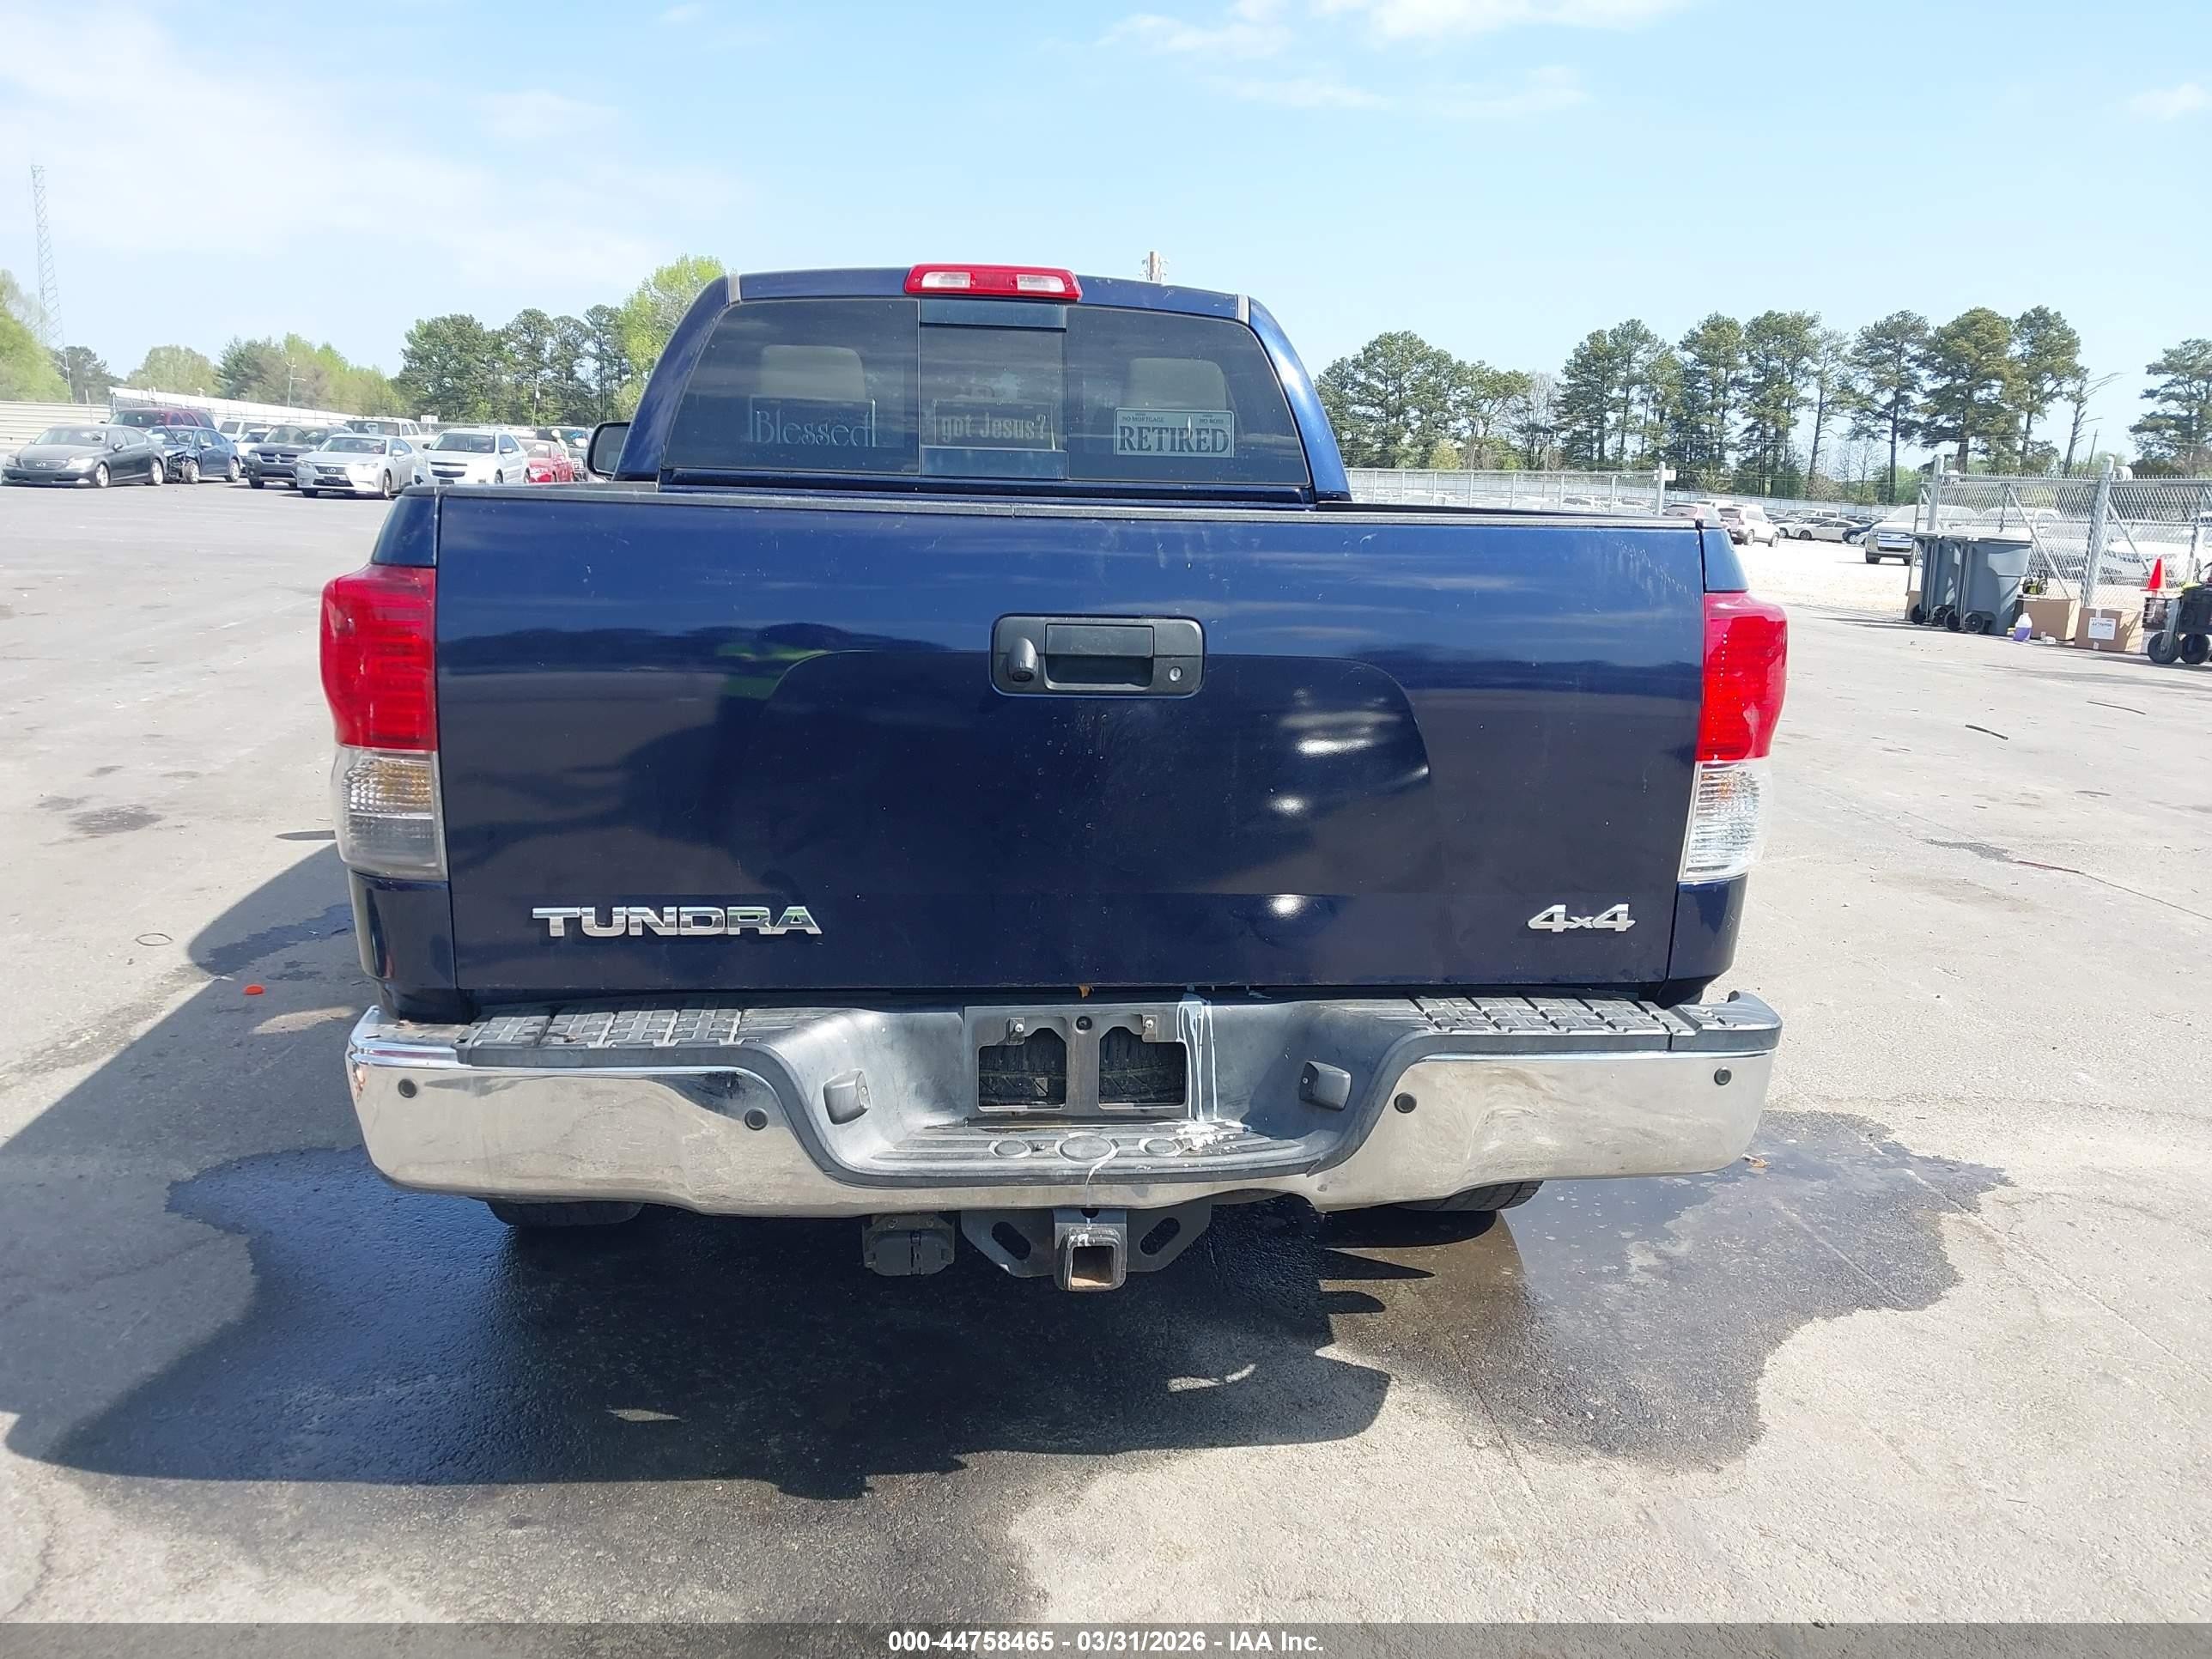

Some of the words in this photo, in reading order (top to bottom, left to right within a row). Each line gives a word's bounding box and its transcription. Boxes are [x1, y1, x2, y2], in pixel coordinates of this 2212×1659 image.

[756, 408, 870, 447] Blessed
[941, 414, 972, 442] got
[980, 412, 1046, 440] Jesus?
[1119, 425, 1230, 453] RETIRED
[532, 906, 823, 938] TUNDRA
[1528, 903, 1636, 933] 4x4
